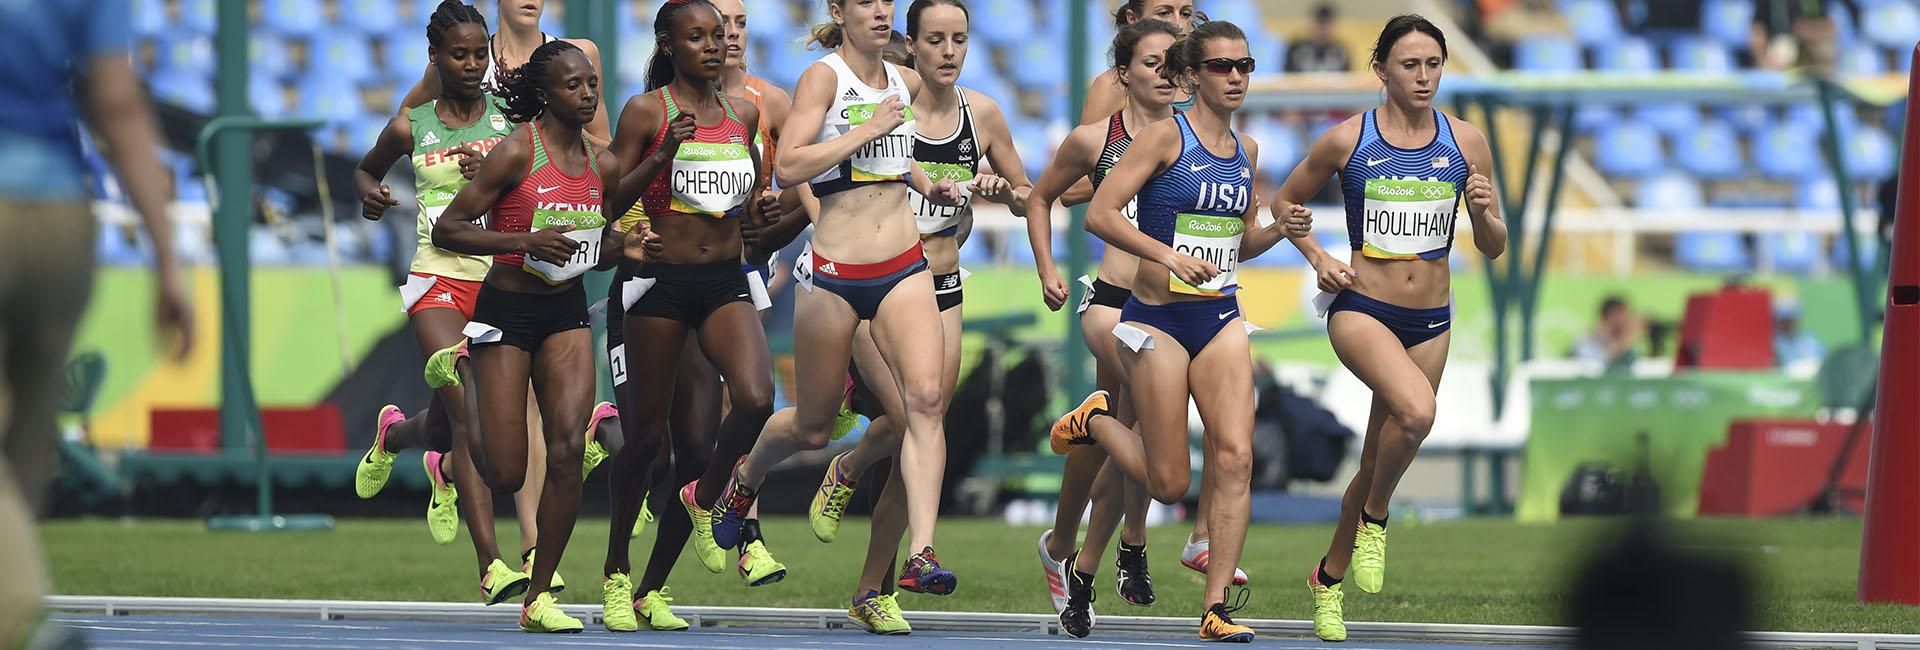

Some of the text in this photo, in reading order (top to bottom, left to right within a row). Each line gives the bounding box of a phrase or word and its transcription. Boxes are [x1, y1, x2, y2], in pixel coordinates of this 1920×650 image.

[674, 169, 753, 195] CHERONO
[1377, 184, 1415, 197] Rio2016
[1194, 181, 1248, 214] USA
[1188, 219, 1222, 232] Rio2016
[1366, 209, 1450, 237] HOULIHAN
[613, 355, 625, 379] 1
